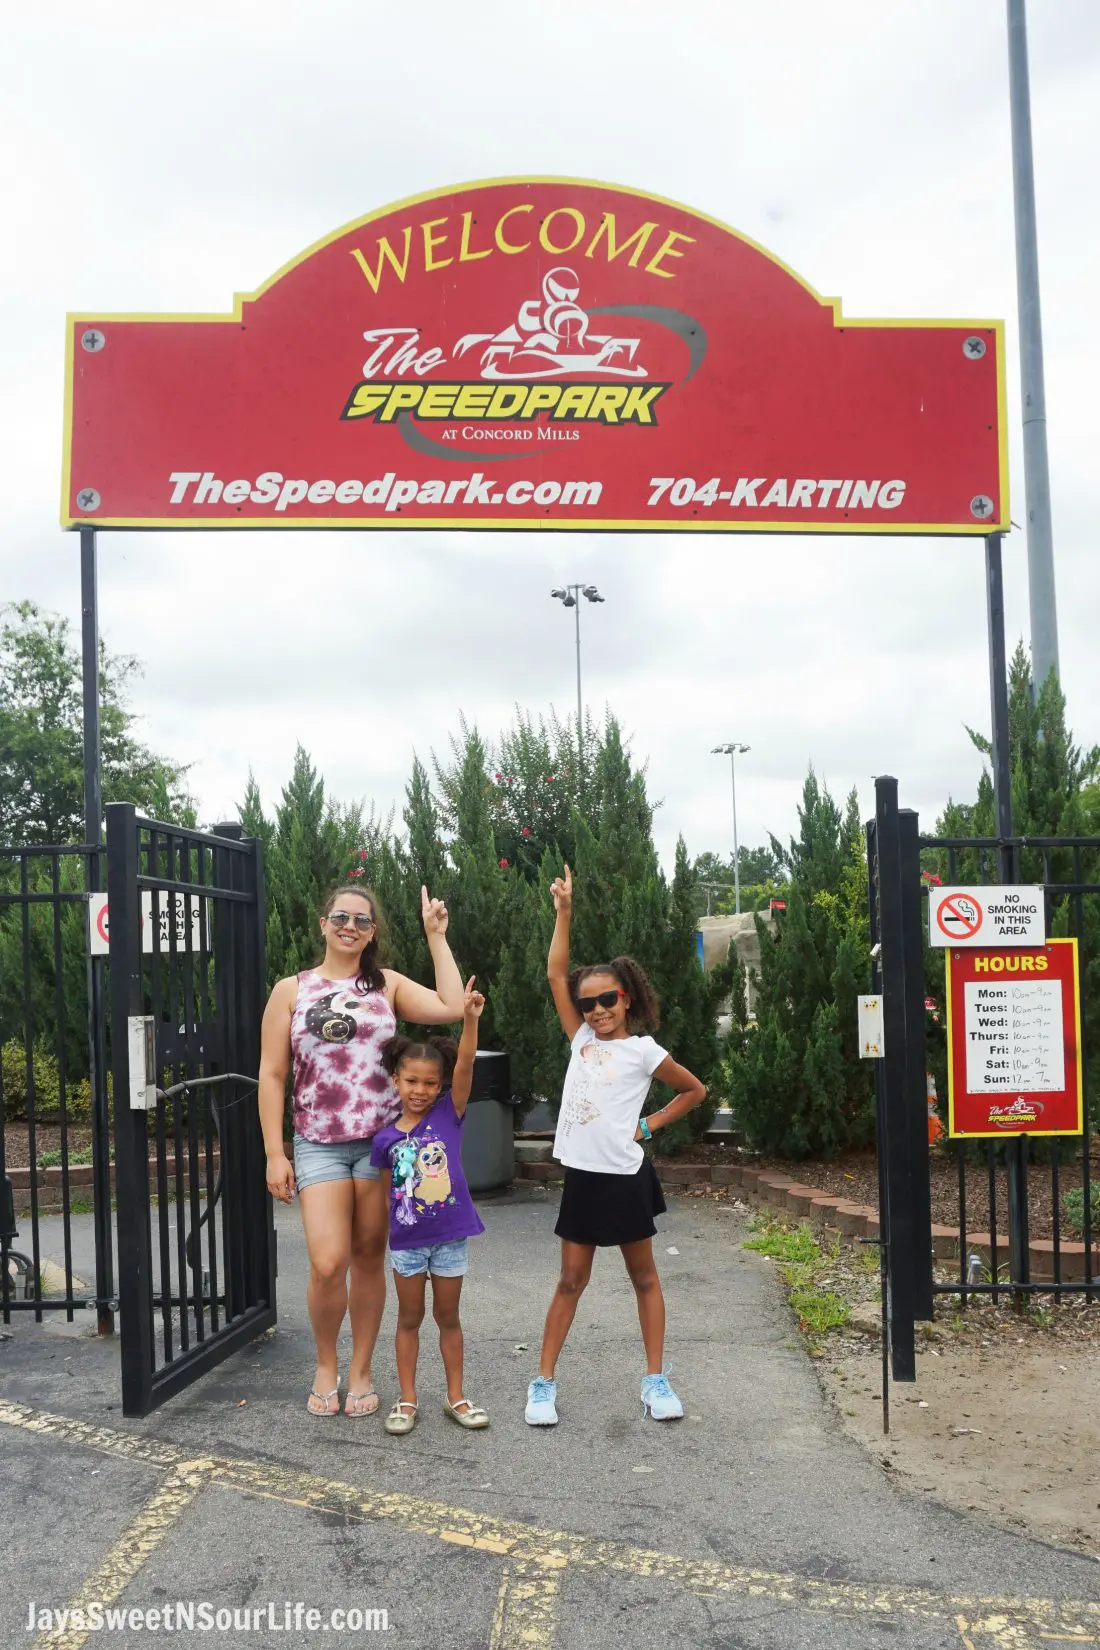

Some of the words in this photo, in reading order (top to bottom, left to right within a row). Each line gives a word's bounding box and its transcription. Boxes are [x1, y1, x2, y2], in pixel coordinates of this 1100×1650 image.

[349, 204, 697, 294] WELCOME
[363, 327, 448, 379] The
[347, 384, 662, 423] SPEEDPARK
[168, 471, 603, 511] TheSpeedpark.com
[647, 476, 907, 509] 704-KARTING
[1004, 895, 1020, 903] NO
[987, 905, 1037, 914] SMOKING
[994, 916, 1005, 924] IN
[1008, 916, 1031, 924] THIS
[998, 926, 1027, 935] AREA
[975, 956, 1048, 972] HOURS
[978, 989, 1007, 998] Mon:
[974, 1003, 1008, 1012] Tues:
[978, 1018, 1008, 1027] Wed:
[969, 1032, 1008, 1041] Thurs:
[989, 1045, 1009, 1054] Fri:
[985, 1060, 1009, 1069] Sat:
[983, 1074, 1010, 1084] Sun:
[988, 1114, 1038, 1122] SPEEDPARK
